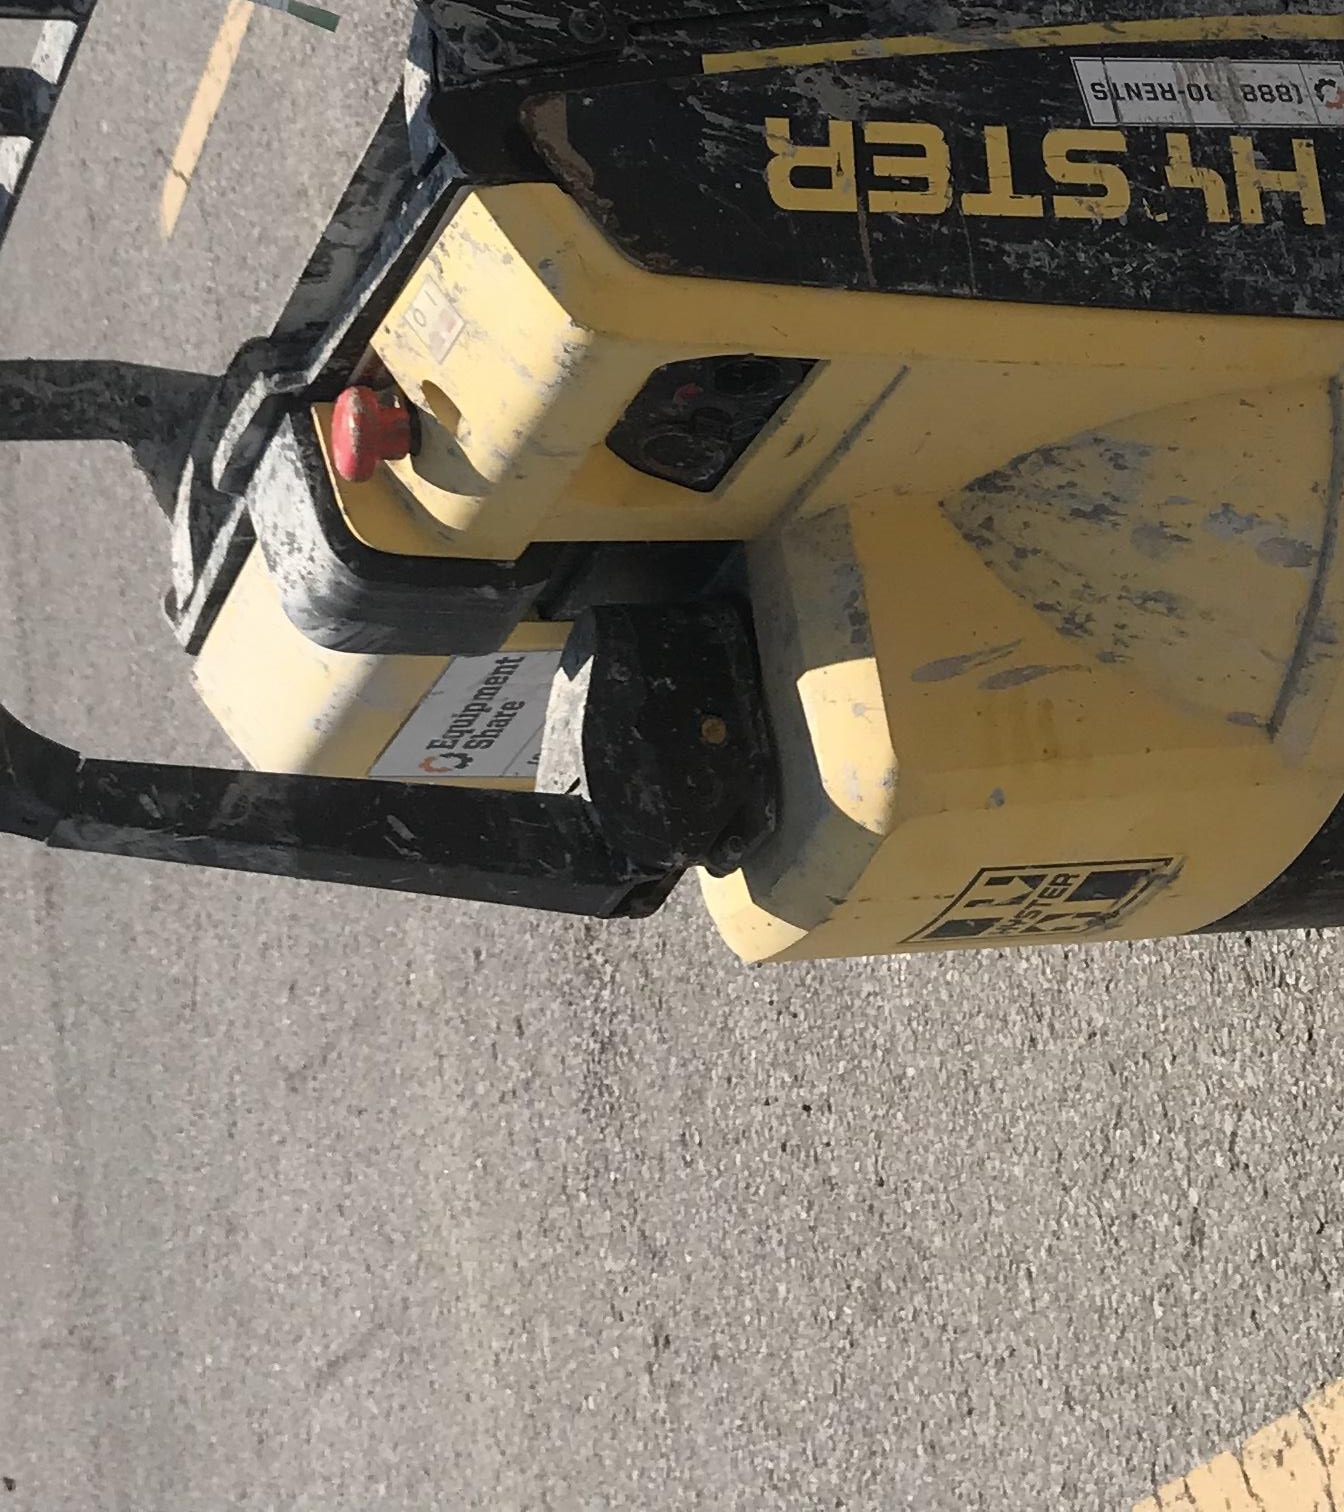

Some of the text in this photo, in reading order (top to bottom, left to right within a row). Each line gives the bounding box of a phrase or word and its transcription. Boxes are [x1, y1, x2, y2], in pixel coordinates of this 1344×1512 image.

[1235, 83, 1304, 104] (888
[764, 117, 1325, 225] HYSTER
[426, 656, 526, 751] Equipment
[463, 700, 526, 751] Share
